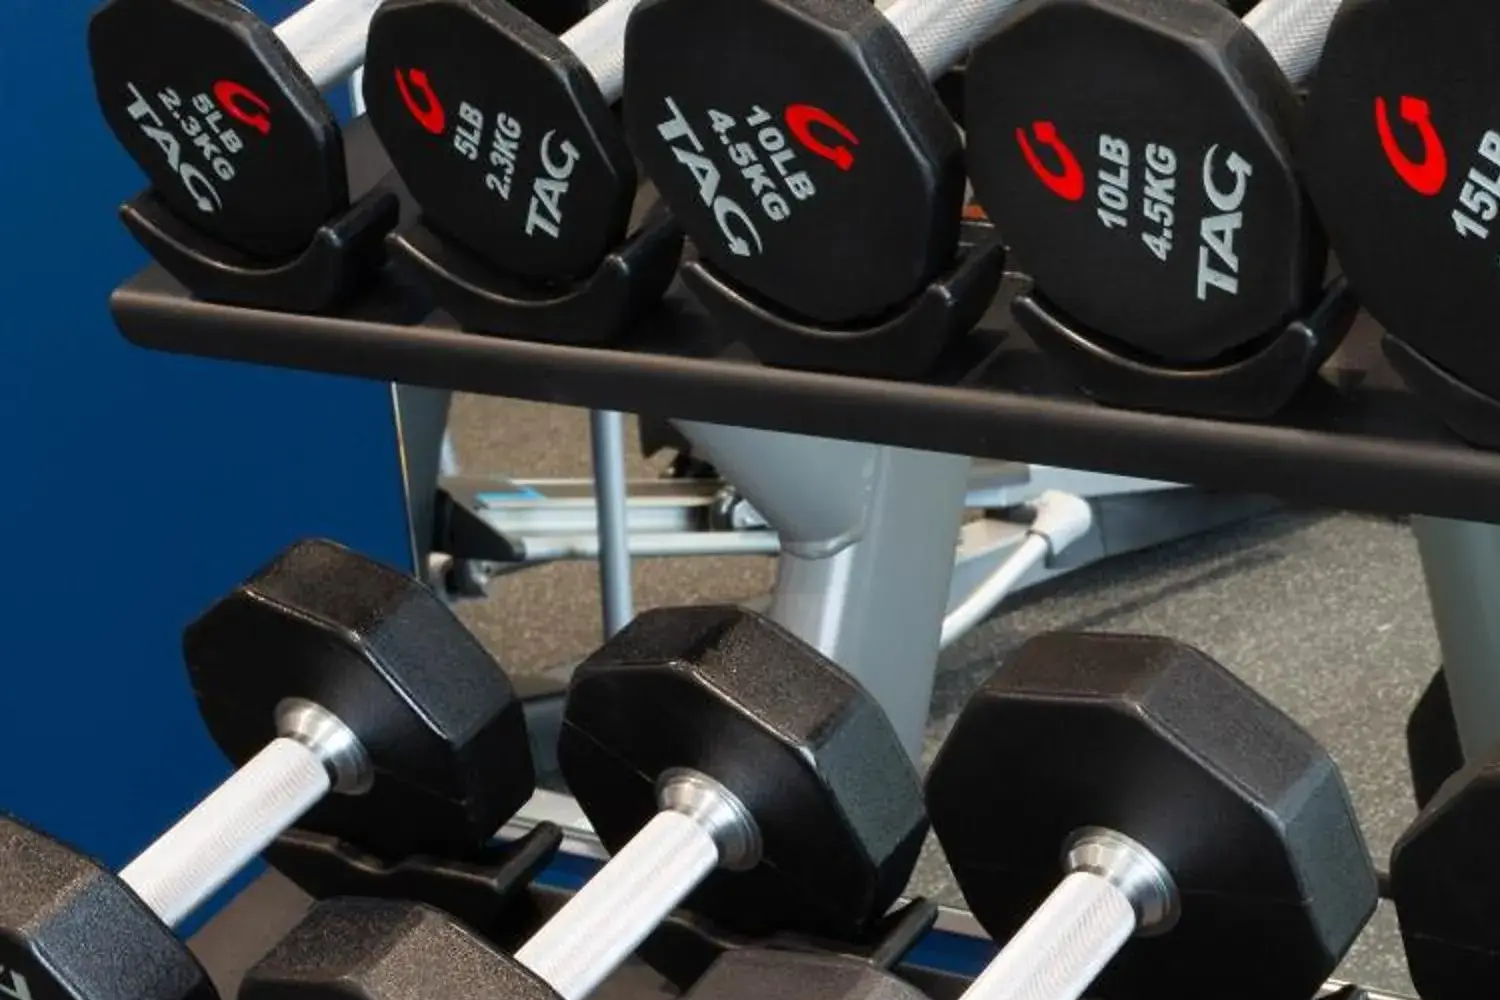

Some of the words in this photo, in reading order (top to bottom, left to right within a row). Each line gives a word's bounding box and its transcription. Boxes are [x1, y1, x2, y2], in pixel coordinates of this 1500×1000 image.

[127, 82, 222, 213] TAG
[159, 88, 235, 181] 2.3KG
[193, 93, 243, 153] 5LB
[453, 101, 484, 161] 5LB
[485, 112, 522, 200] 2.3KG
[707, 109, 791, 221] 4.5KG
[746, 105, 816, 201] 10LB
[525, 130, 580, 239] TAG
[657, 96, 763, 257] TAG
[1096, 134, 1130, 230] 10LB
[1141, 143, 1177, 261] 4.5KG
[1197, 143, 1253, 301] TAG
